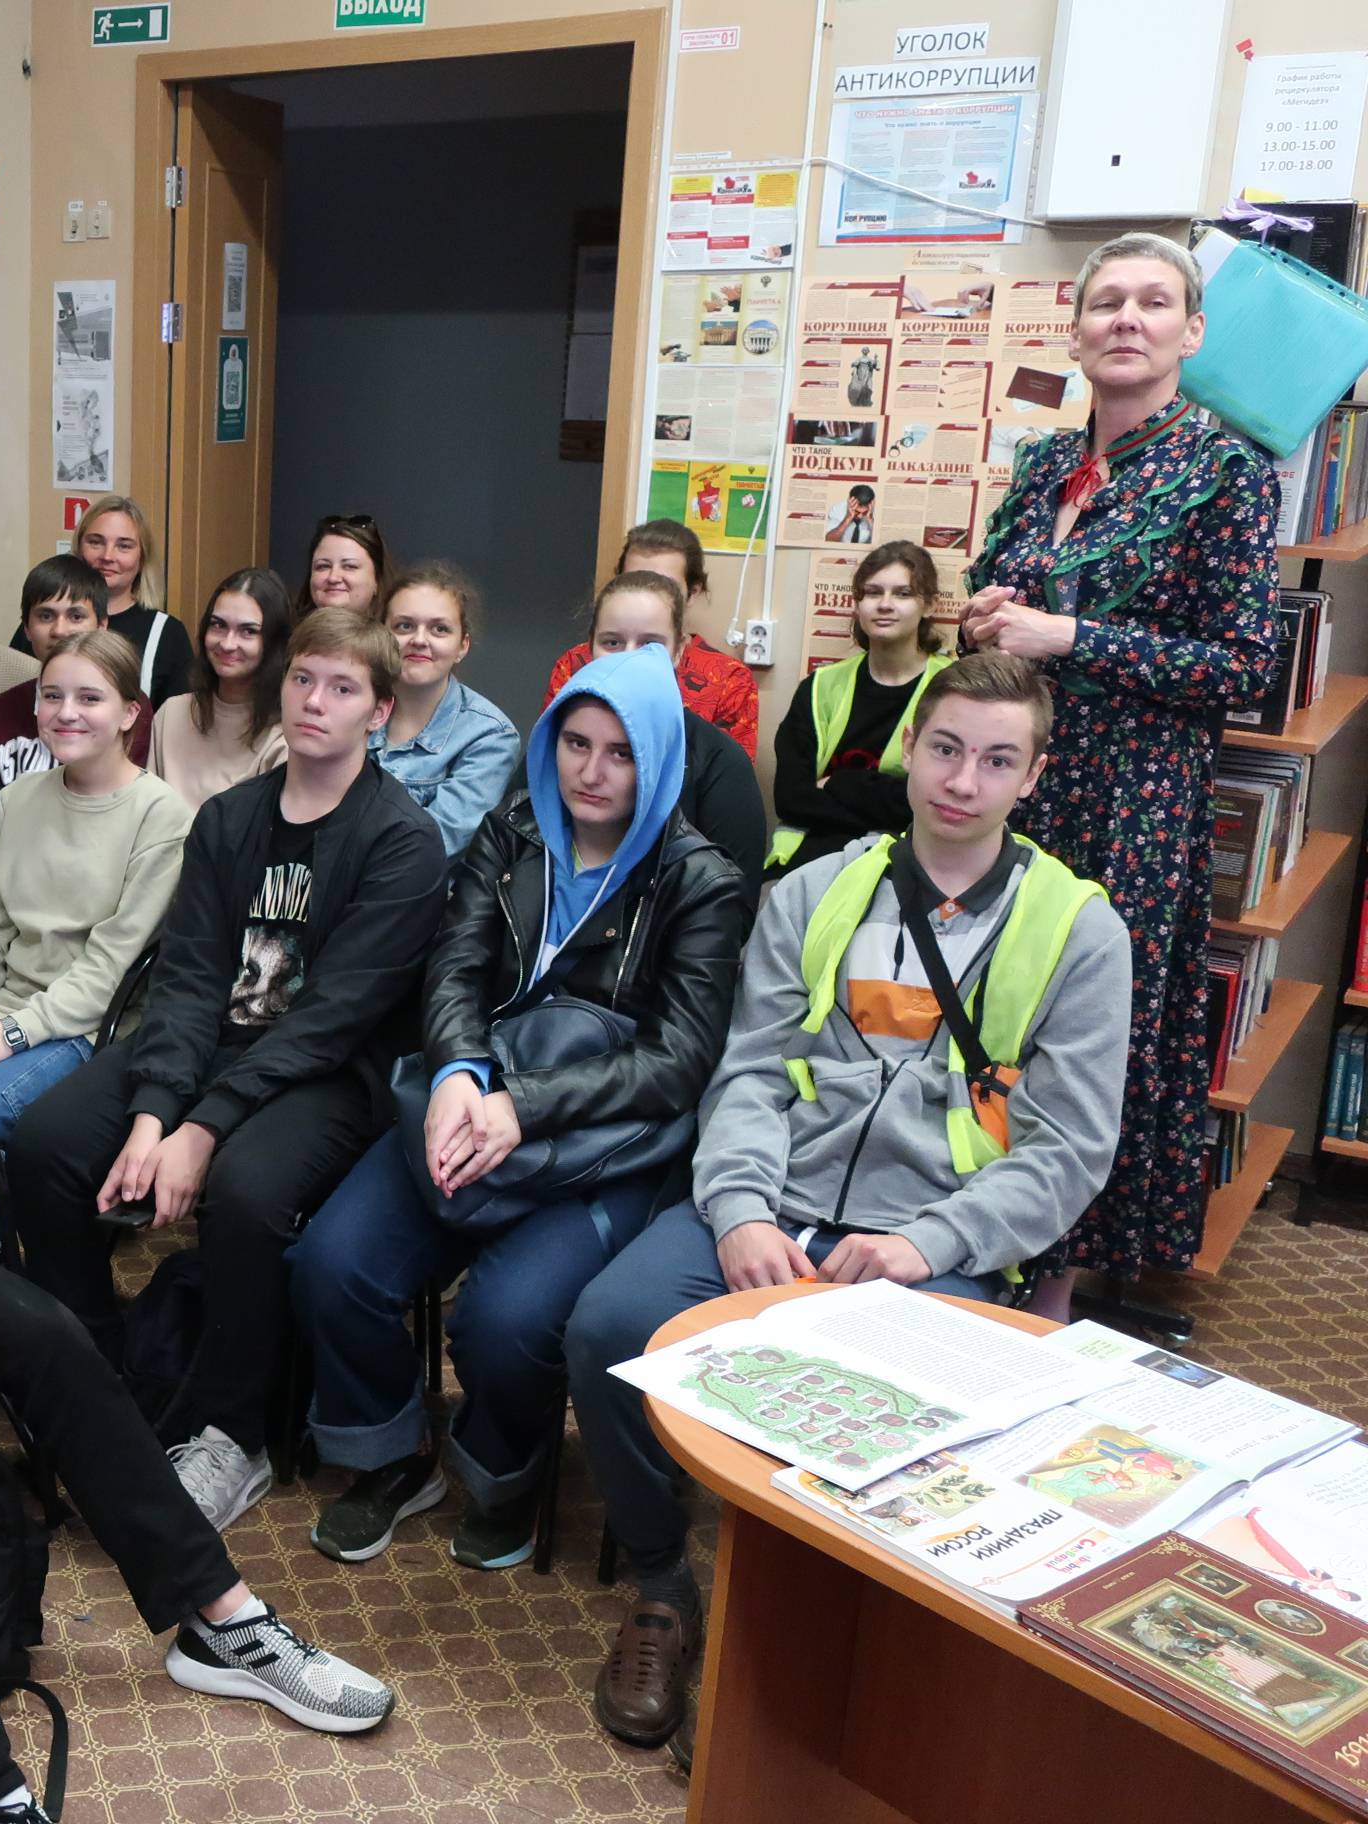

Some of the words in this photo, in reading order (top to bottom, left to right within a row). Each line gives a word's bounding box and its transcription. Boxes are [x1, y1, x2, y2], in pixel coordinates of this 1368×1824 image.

[339, 0, 420, 17] ВЫХОД
[897, 31, 986, 53] УГОЛОК
[835, 65, 1035, 92] АНТИКОРРУПЦИИ
[1310, 72, 1341, 82] работы
[1265, 121, 1293, 133] 9.00
[1304, 120, 1338, 131] 11.00
[1263, 140, 1336, 152] 13.00-15.00
[1260, 159, 1333, 171] 17.00-18.00
[804, 321, 888, 333] КОРРУПЦИЯ
[902, 322, 990, 333] КОРРУПЦИЯ
[1005, 323, 1073, 334] КОРРУП
[792, 447, 806, 455] ЧТО
[792, 454, 874, 472] ПОДКУП
[887, 461, 974, 475] НАКАЗАНИЕ
[814, 592, 855, 608] ВЗЯ
[926, 1525, 993, 1557] РОССИИ
[970, 1509, 1063, 1560] ПРАЗДНИКИ
